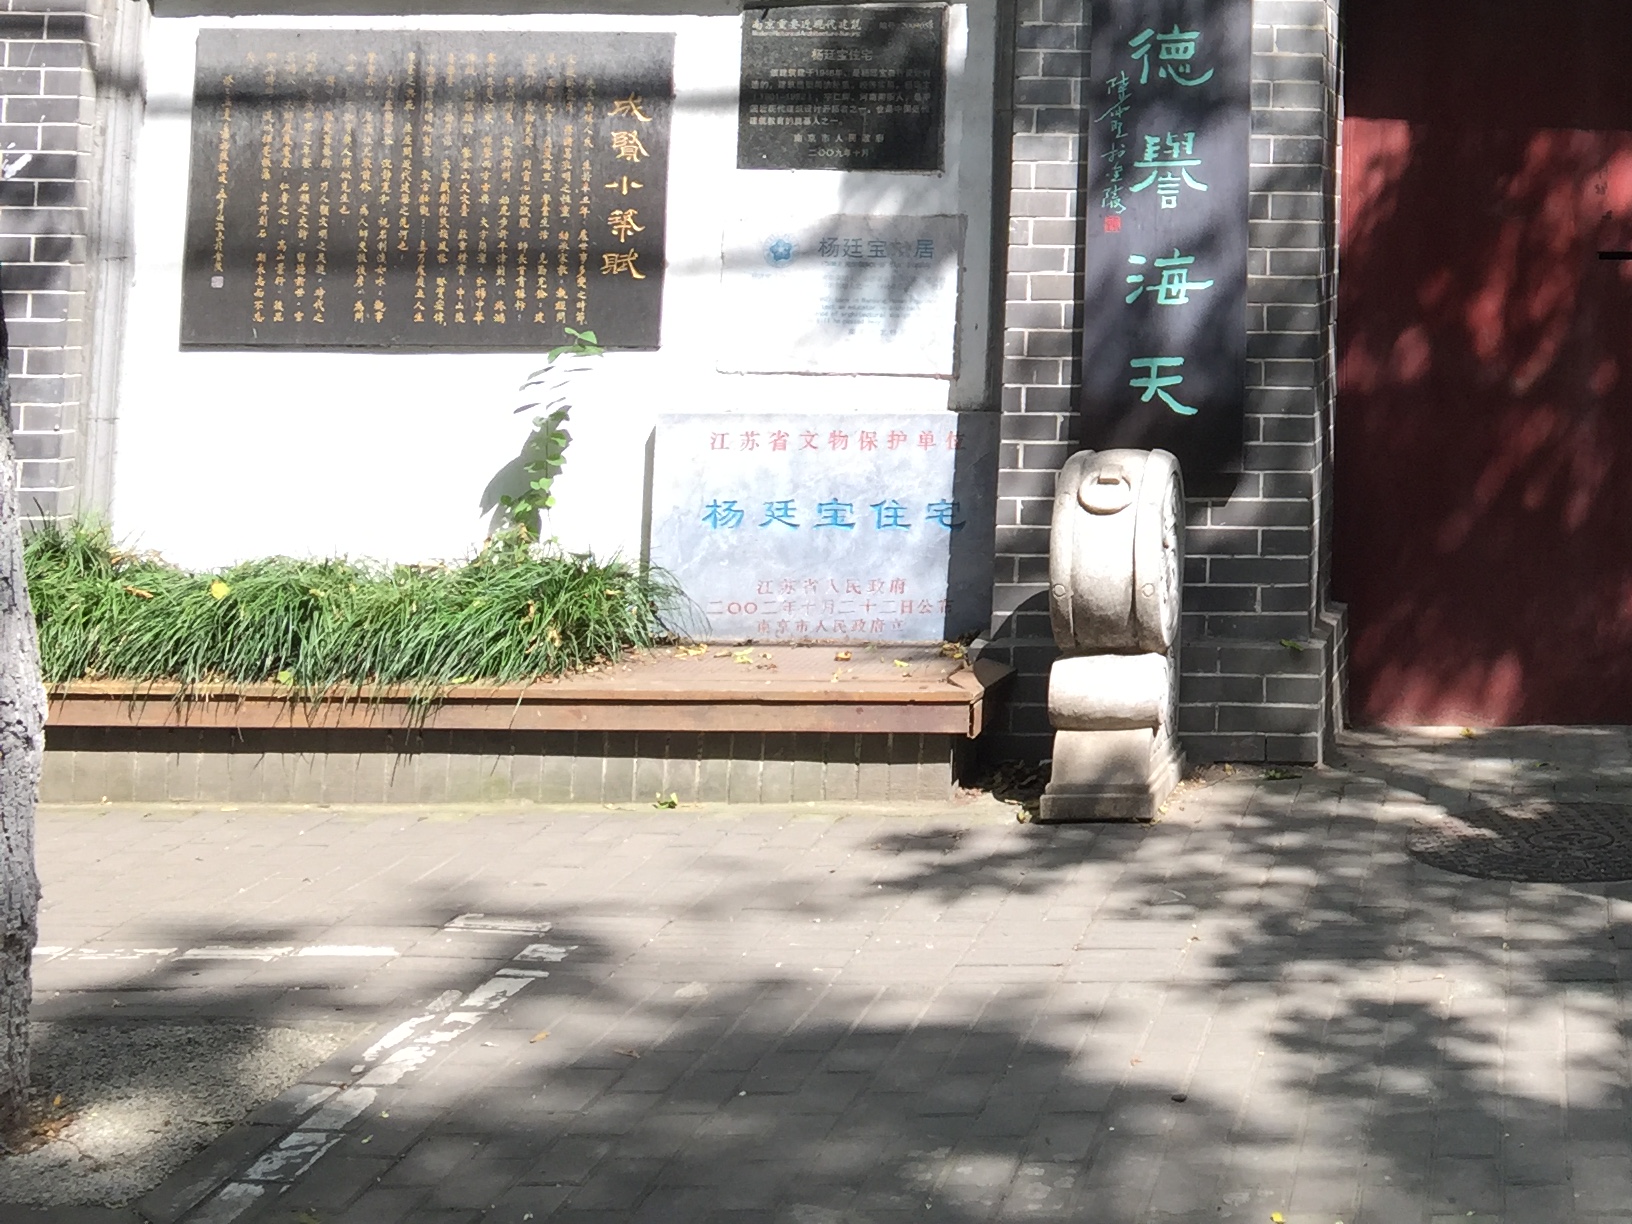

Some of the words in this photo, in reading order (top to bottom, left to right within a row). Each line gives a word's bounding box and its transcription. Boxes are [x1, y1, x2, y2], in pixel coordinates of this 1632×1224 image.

[600, 92, 653, 280] 成賢小築賦
[709, 430, 965, 452] 江苏省文物保护单位
[701, 497, 967, 532] 杨廷宝住宅
[757, 579, 907, 596] 江苏省人民政府
[757, 619, 905, 634] 南京市人民政府立
